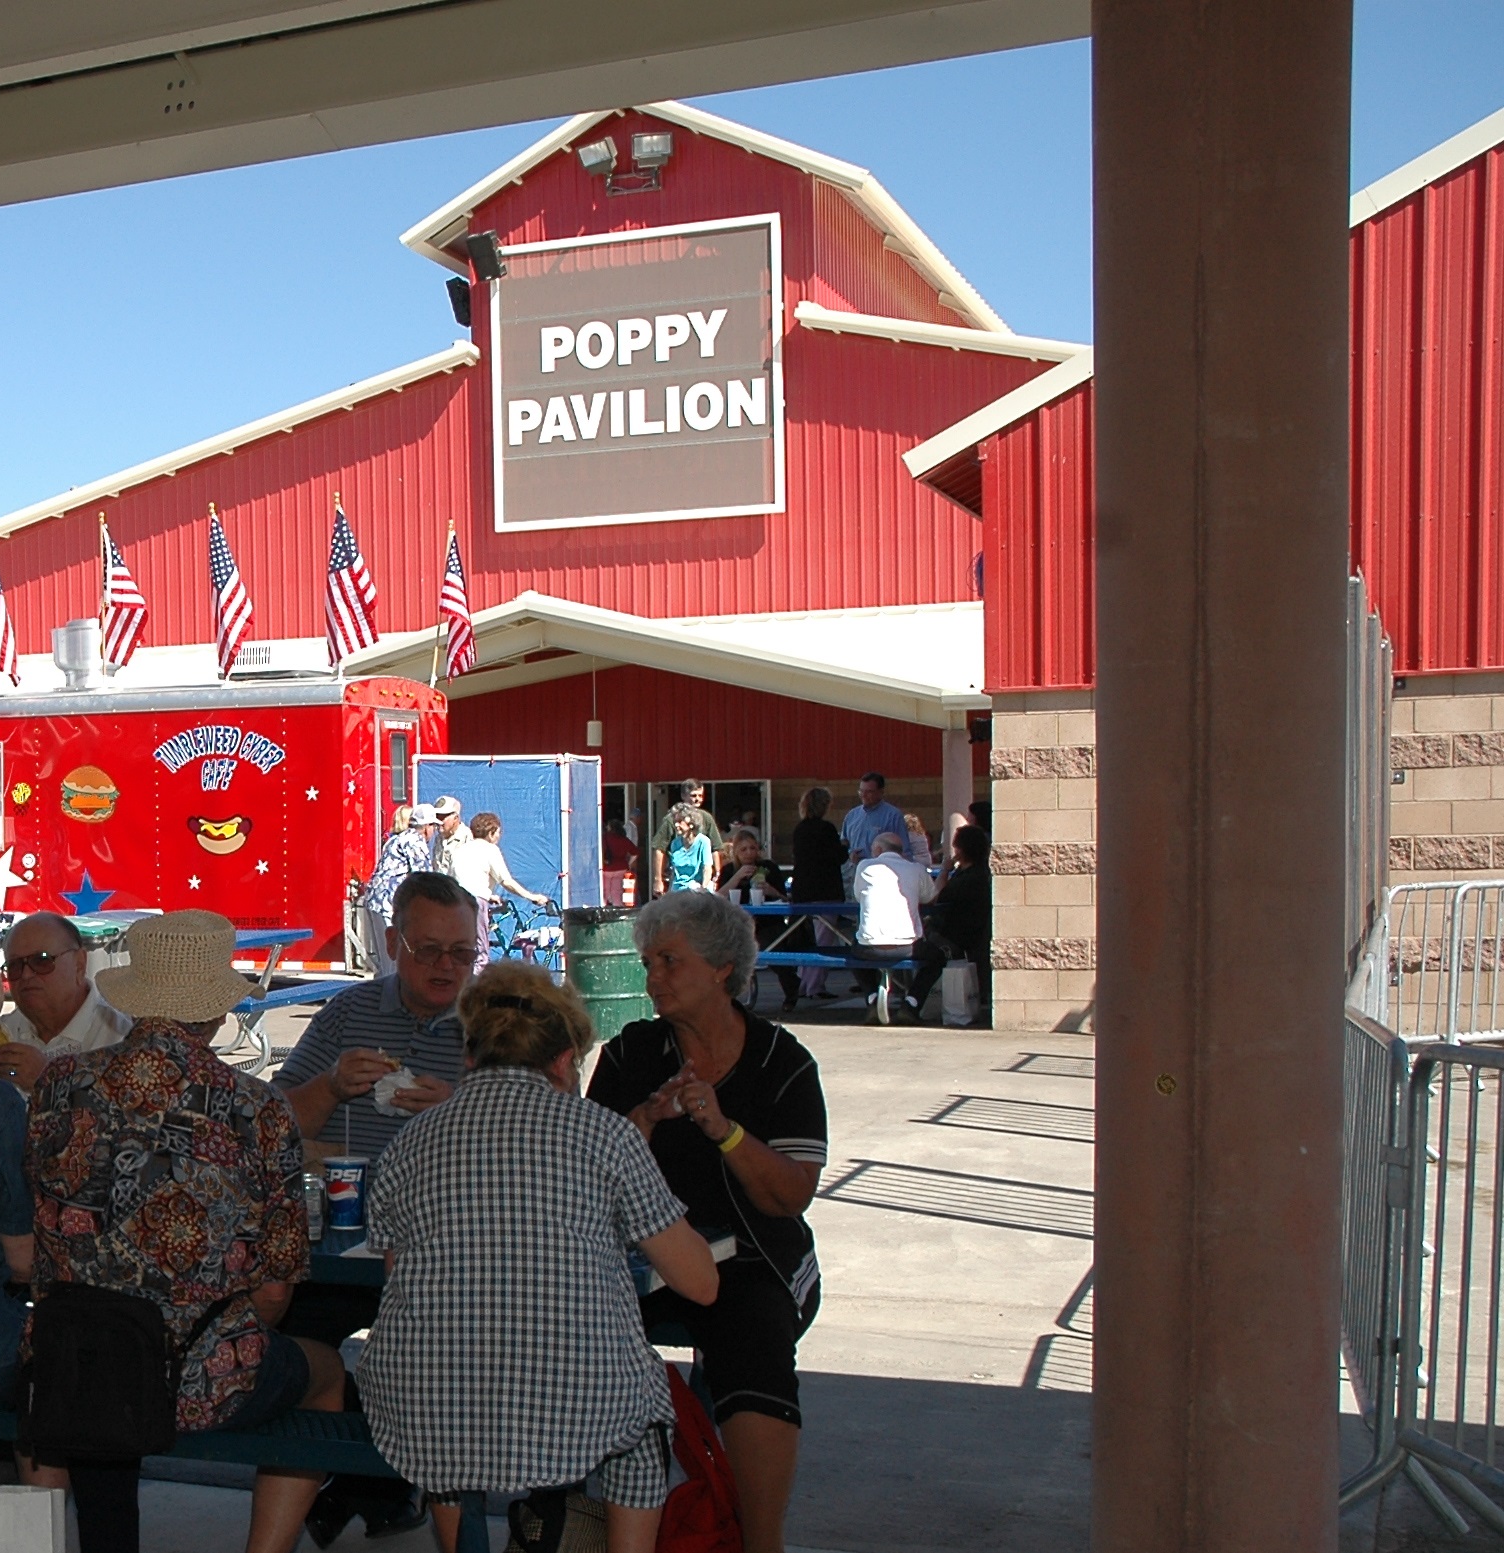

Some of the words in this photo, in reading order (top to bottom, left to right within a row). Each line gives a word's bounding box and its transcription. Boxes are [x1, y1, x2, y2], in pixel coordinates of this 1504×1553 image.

[540, 308, 728, 374] POPPY
[507, 377, 767, 446] PAVILION
[152, 725, 242, 774] TUMBLEWEED
[239, 731, 287, 775] CYBER
[200, 757, 238, 792] CAFE
[326, 1168, 363, 1182] PSI
